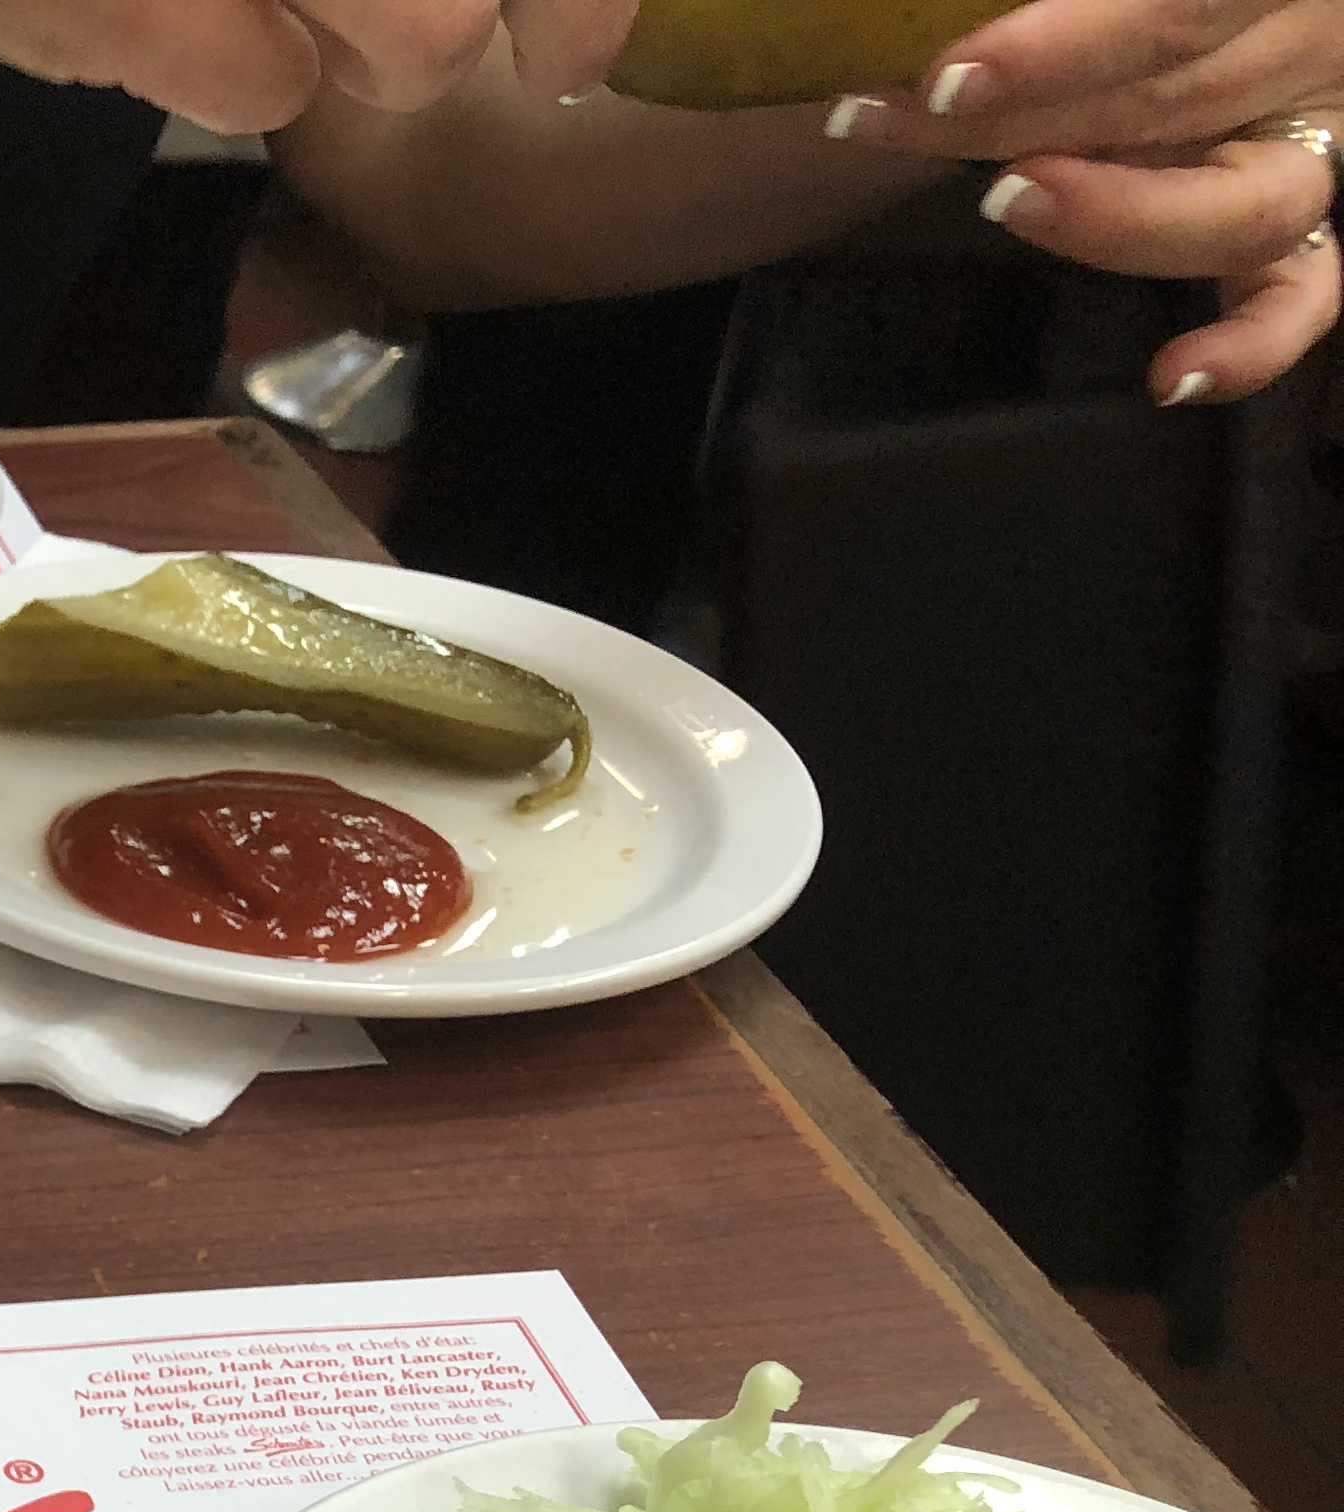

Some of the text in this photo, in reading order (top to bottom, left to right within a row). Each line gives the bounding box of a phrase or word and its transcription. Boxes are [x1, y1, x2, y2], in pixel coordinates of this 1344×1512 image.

[74, 1363, 528, 1401] Nana Mouskouri, Jean Chrétien, Ken Dryden,
[87, 1349, 502, 1385] Céline Dion, Hank Aaron, Burt Lancaster,
[79, 1378, 536, 1419] Jerry Lewis, Guy Lafleur, Jean Béliveau, Rusty
[121, 1403, 386, 1430] Staub, Raymond Bourque,
[341, 1417, 409, 1430] viande
